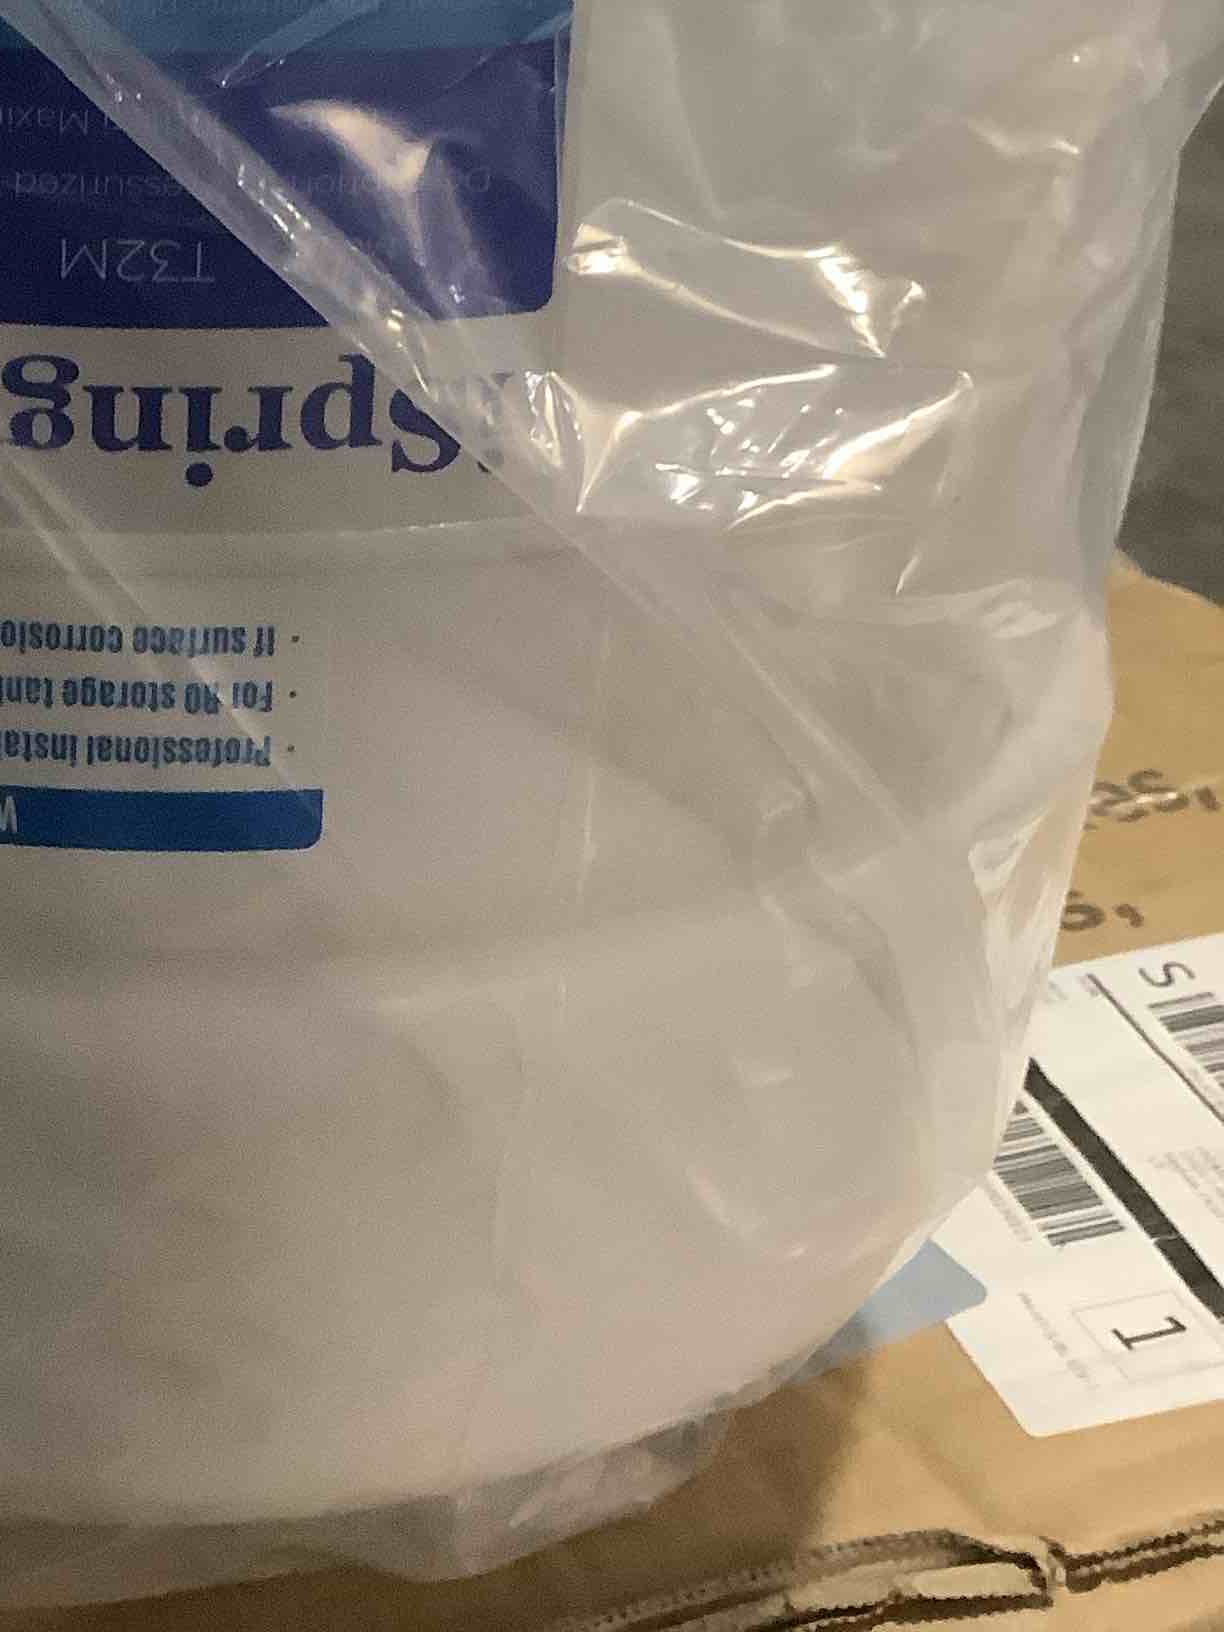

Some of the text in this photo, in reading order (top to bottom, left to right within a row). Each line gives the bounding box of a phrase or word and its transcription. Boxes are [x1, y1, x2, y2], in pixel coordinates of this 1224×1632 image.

[58, 236, 218, 284] T32M
[131, 625, 247, 657] surface
[248, 627, 275, 657] If
[62, 675, 177, 711] storage
[228, 681, 274, 713] For
[85, 732, 273, 769] Professional
